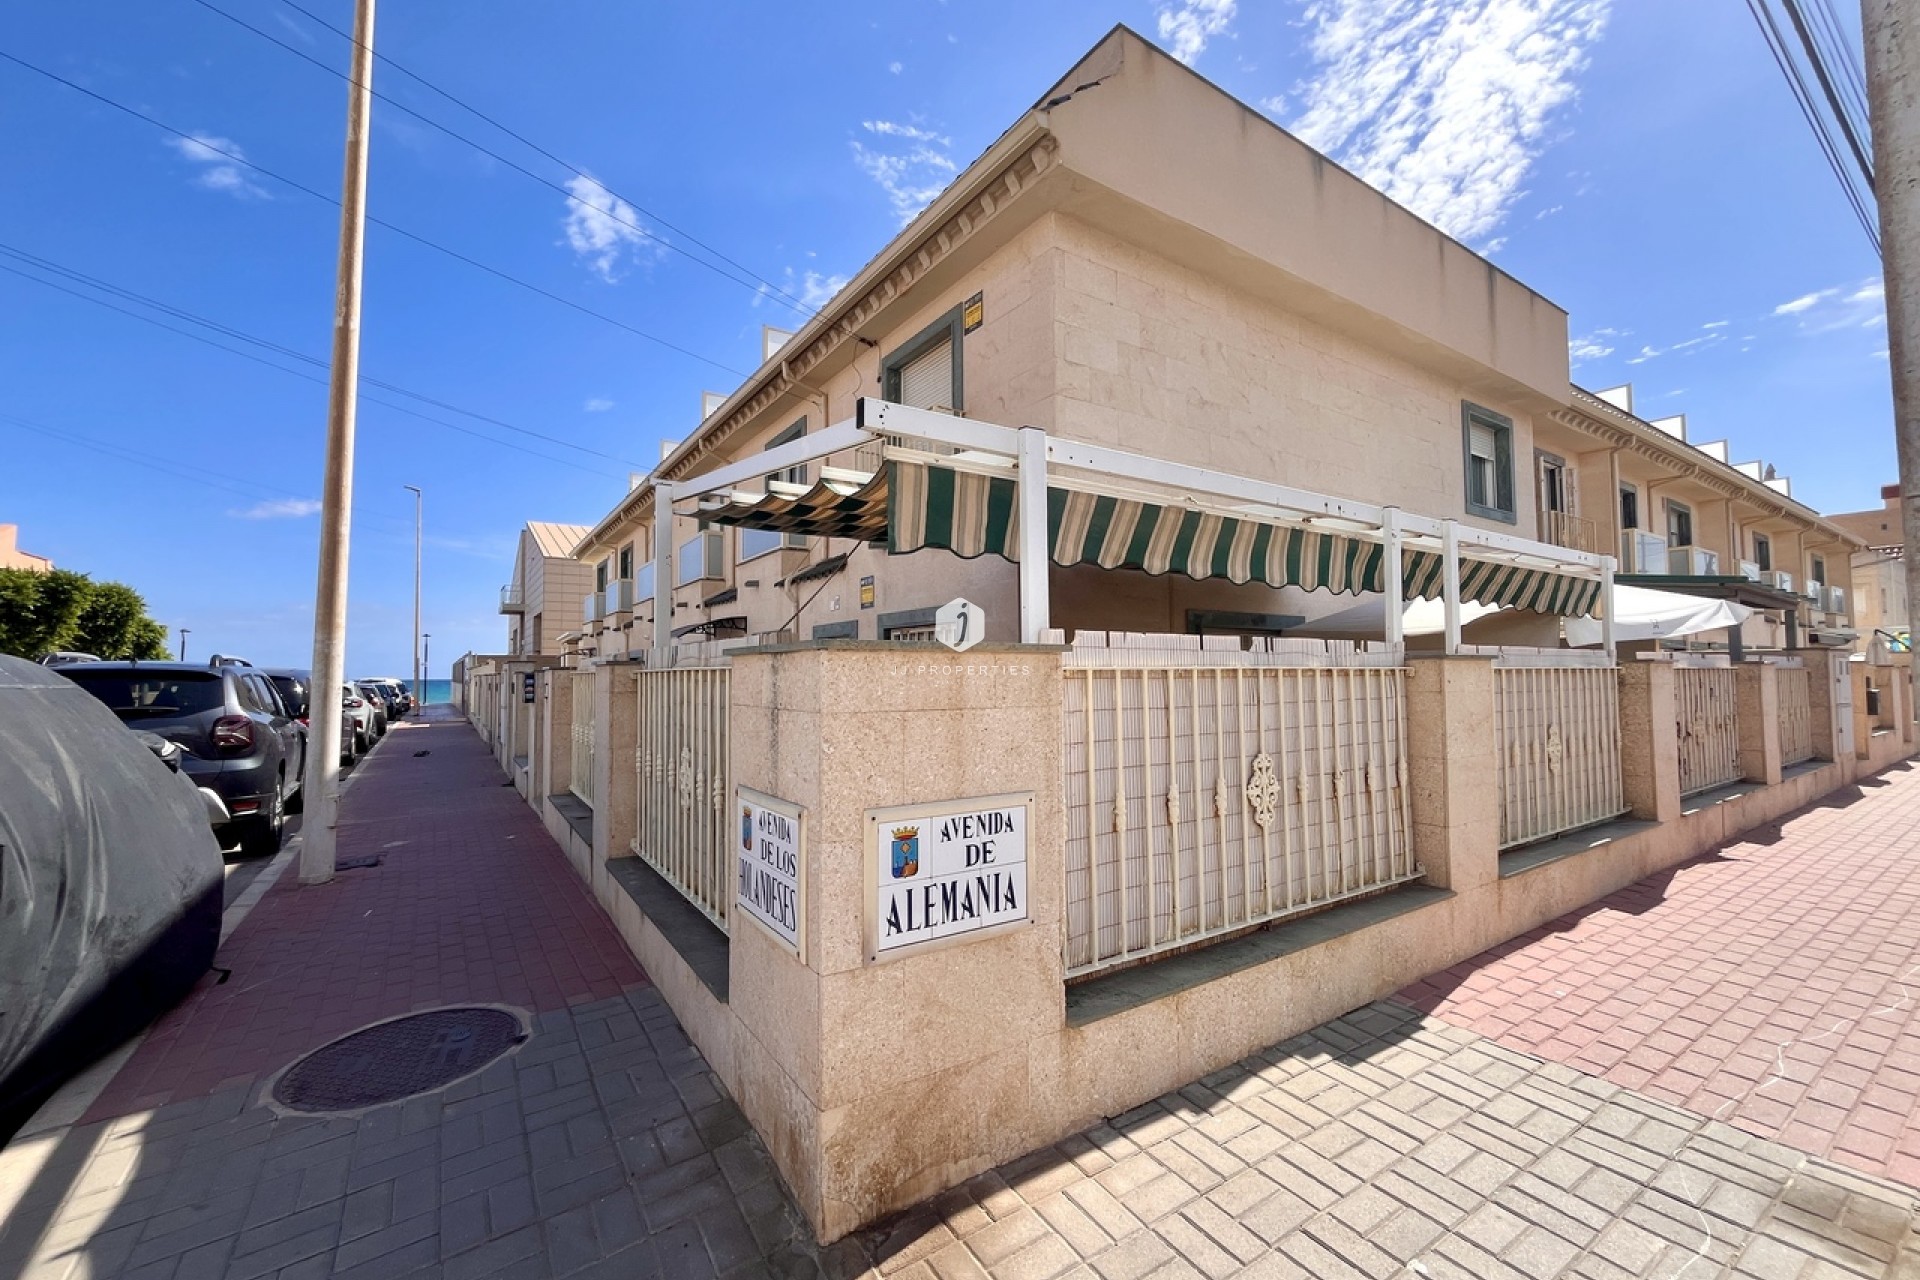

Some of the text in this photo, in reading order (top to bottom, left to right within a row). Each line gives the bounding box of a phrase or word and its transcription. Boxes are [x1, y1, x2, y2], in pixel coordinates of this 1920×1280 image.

[941, 812, 1014, 843] AVENIDA
[761, 838, 796, 877] DE LOS
[965, 840, 996, 867] DE
[886, 872, 1017, 937] ALEMANIA
